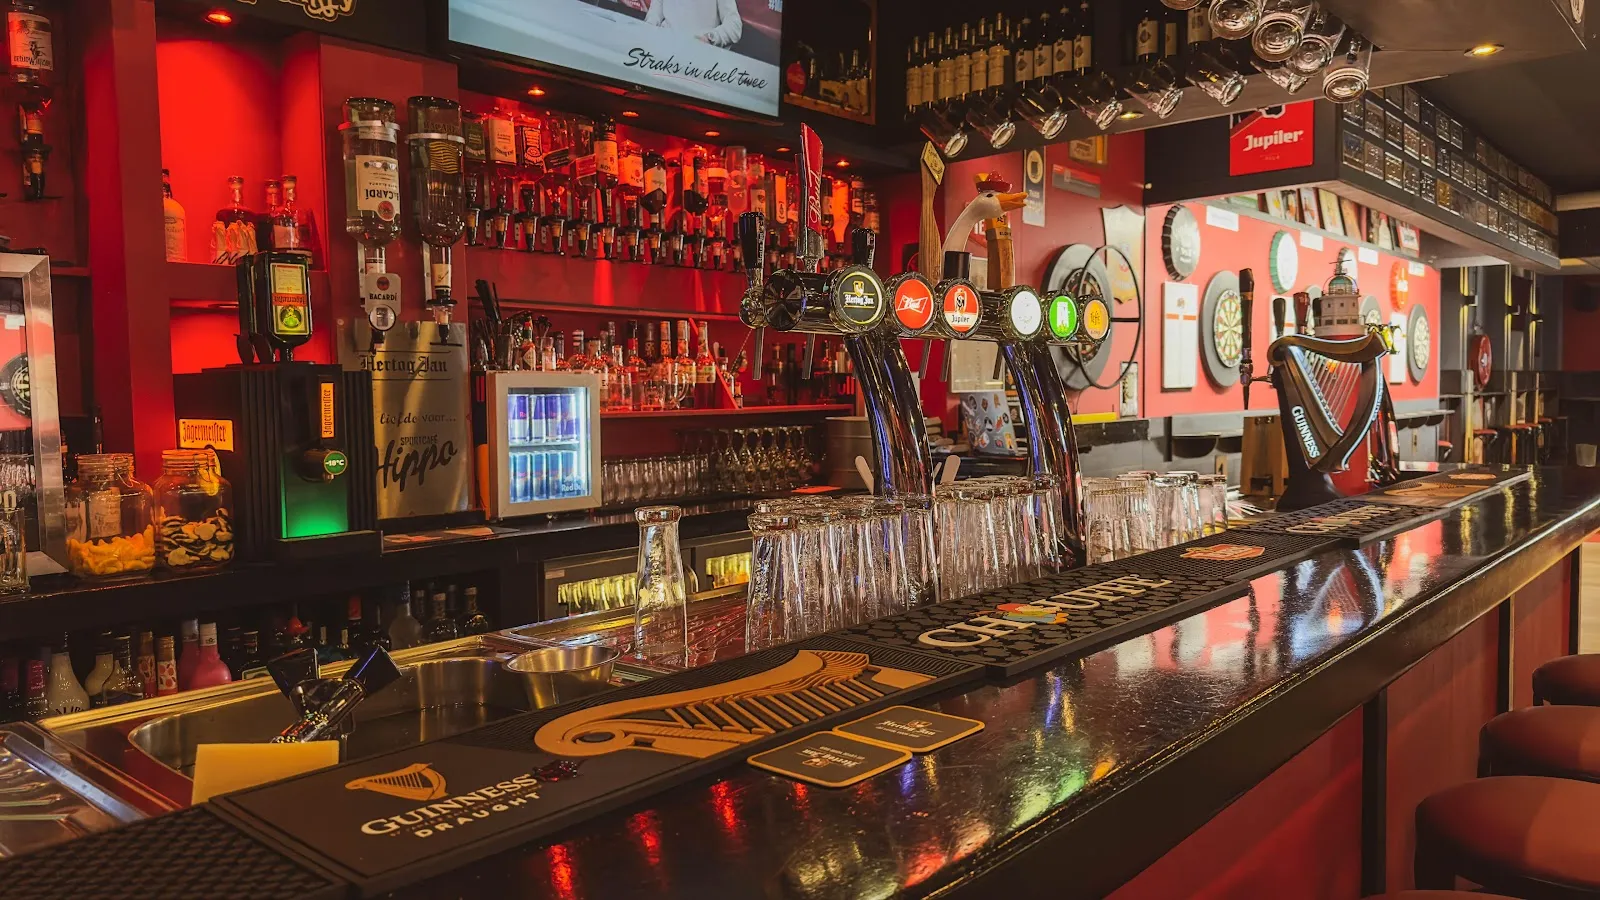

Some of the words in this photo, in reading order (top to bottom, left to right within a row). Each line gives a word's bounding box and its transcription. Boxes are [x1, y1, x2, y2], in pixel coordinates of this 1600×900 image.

[623, 47, 681, 74] Straks
[684, 62, 702, 78] in
[703, 62, 737, 84] deel
[738, 70, 769, 89] twee
[1242, 130, 1304, 151] Jupiler
[808, 170, 823, 224] Bud
[369, 291, 398, 301] BACARDÍ
[951, 315, 970, 323] Jupiler
[358, 353, 416, 375] Hertog
[417, 356, 448, 377] Jan
[380, 412, 417, 427] liefde
[1291, 405, 1321, 459] GUINNESS
[400, 434, 438, 446] SPORTCAFÉ
[375, 439, 458, 493] Hippo
[360, 773, 539, 836] GUINNESS
[414, 791, 541, 838] DRAUGHT
